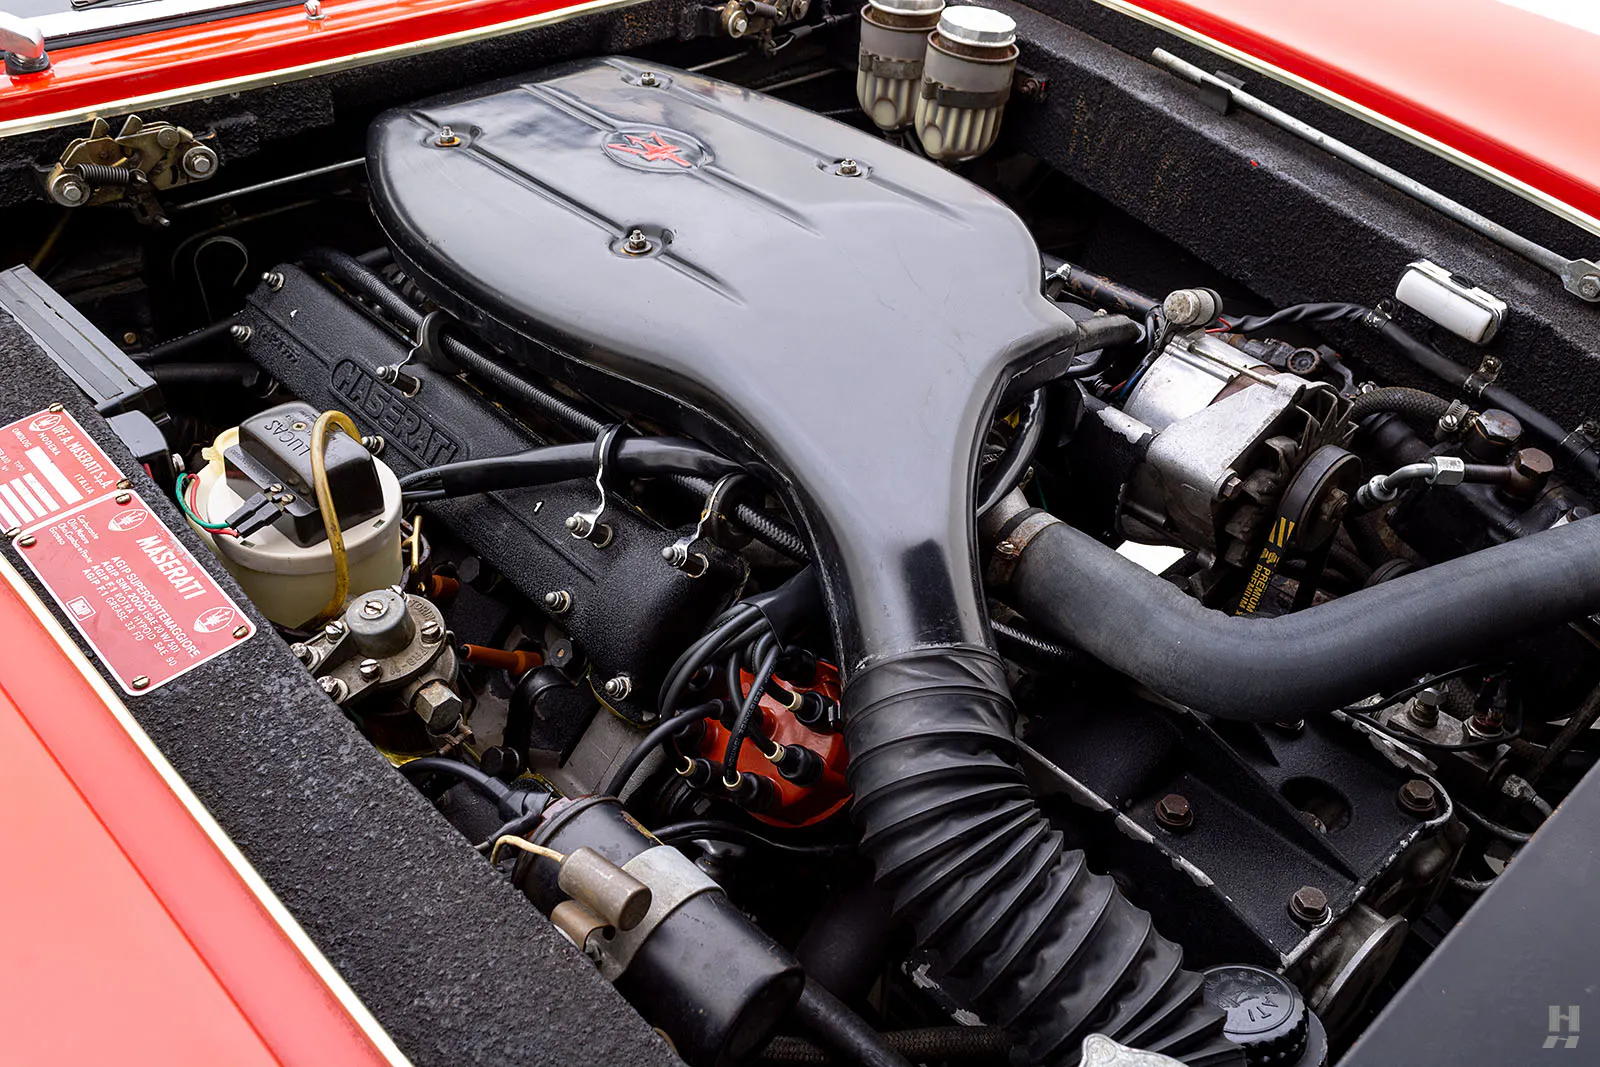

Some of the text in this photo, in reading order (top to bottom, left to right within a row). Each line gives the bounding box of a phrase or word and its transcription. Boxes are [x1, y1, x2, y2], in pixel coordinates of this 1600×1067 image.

[264, 420, 310, 456] LUCAS
[334, 360, 457, 467] MASERATI
[37, 431, 95, 495] MODENA ITALIA
[66, 441, 103, 474] MASERATI
[533, 501, 543, 513] 1
[82, 568, 101, 585] AGIP
[105, 597, 129, 621] GREASE
[124, 621, 136, 631] 33
[100, 561, 120, 577] AGIP
[127, 592, 147, 611] 2000
[153, 624, 165, 634] 20
[136, 535, 207, 600] MASERATI
[1246, 567, 1271, 613] PREMIUM
[91, 564, 110, 581] AGIP
[114, 592, 135, 614] ROTRA
[133, 615, 157, 640] HYPOID
[153, 641, 169, 656] SAE
[111, 556, 201, 658] AGIP SUPERCORTEMAGGIORE
